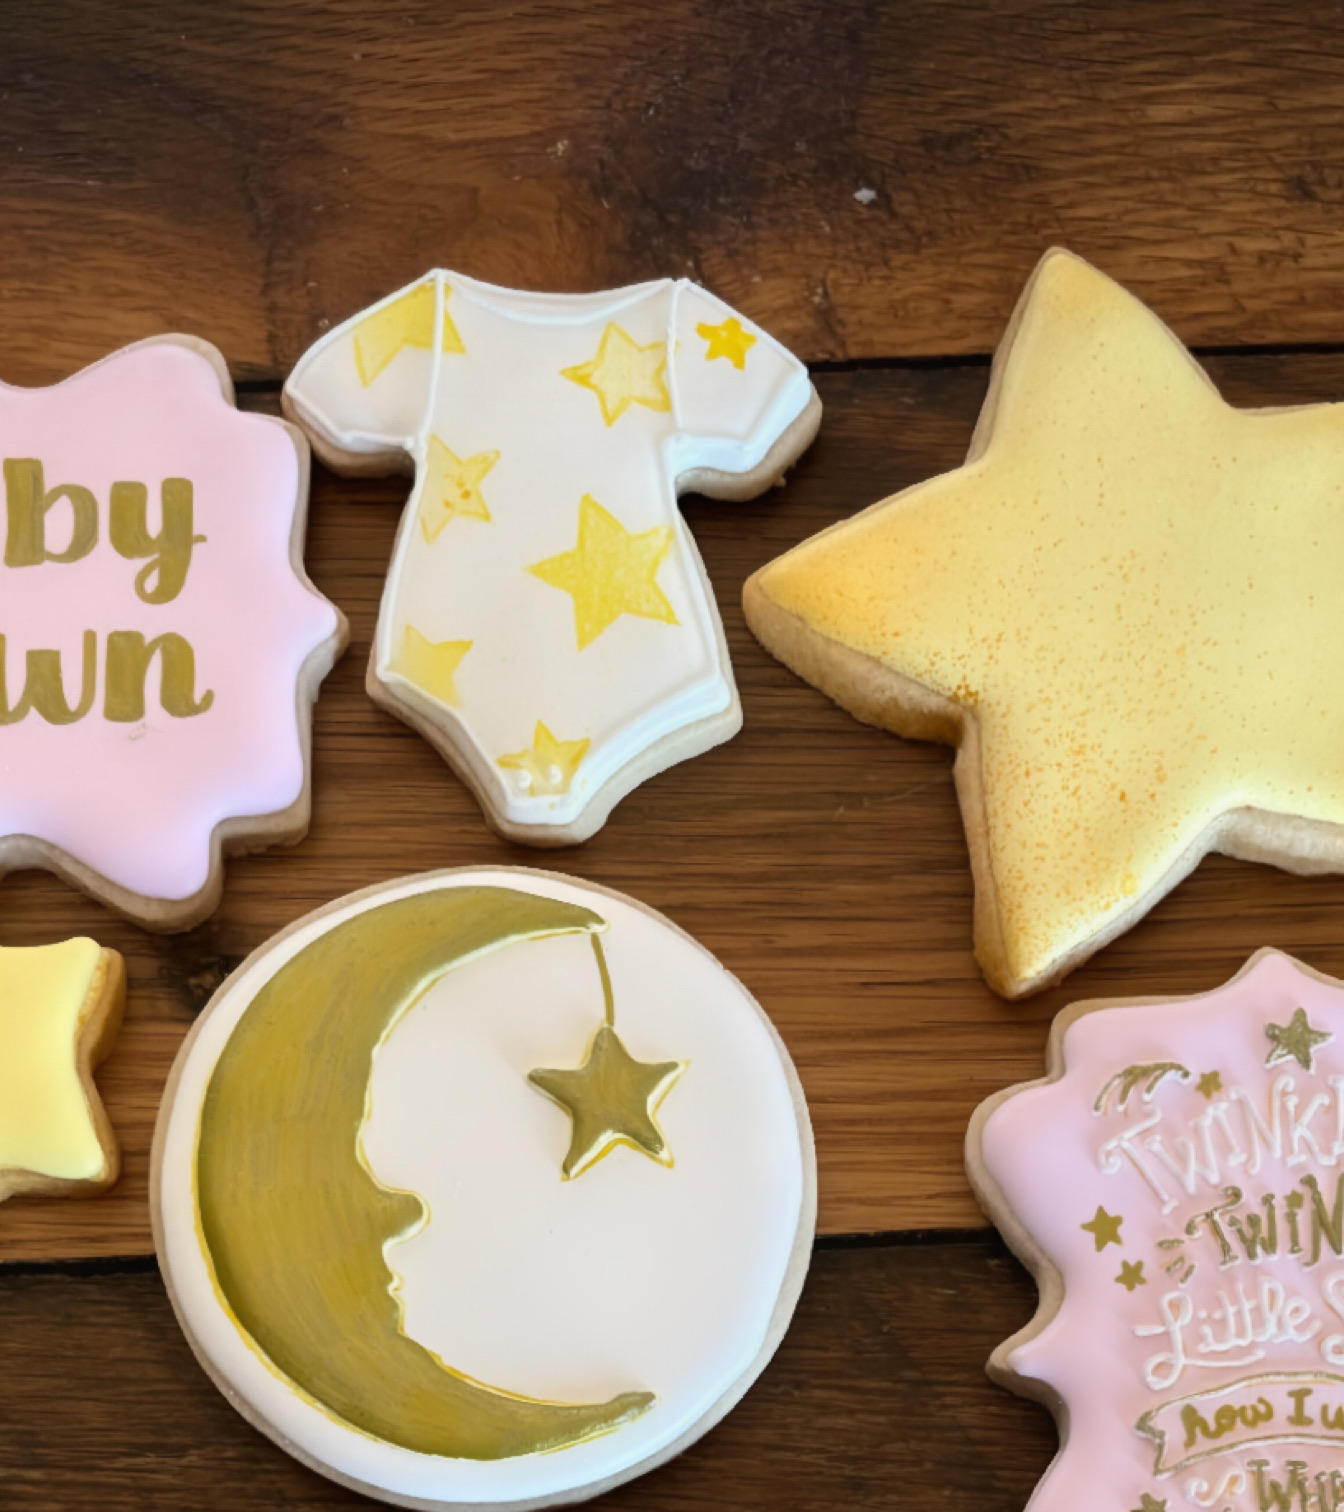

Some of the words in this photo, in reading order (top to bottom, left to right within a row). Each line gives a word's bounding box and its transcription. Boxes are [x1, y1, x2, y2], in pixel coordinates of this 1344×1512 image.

[1134, 1283, 1324, 1390] Little
[1180, 1400, 1274, 1449] how
[1285, 1386, 1315, 1423] I
